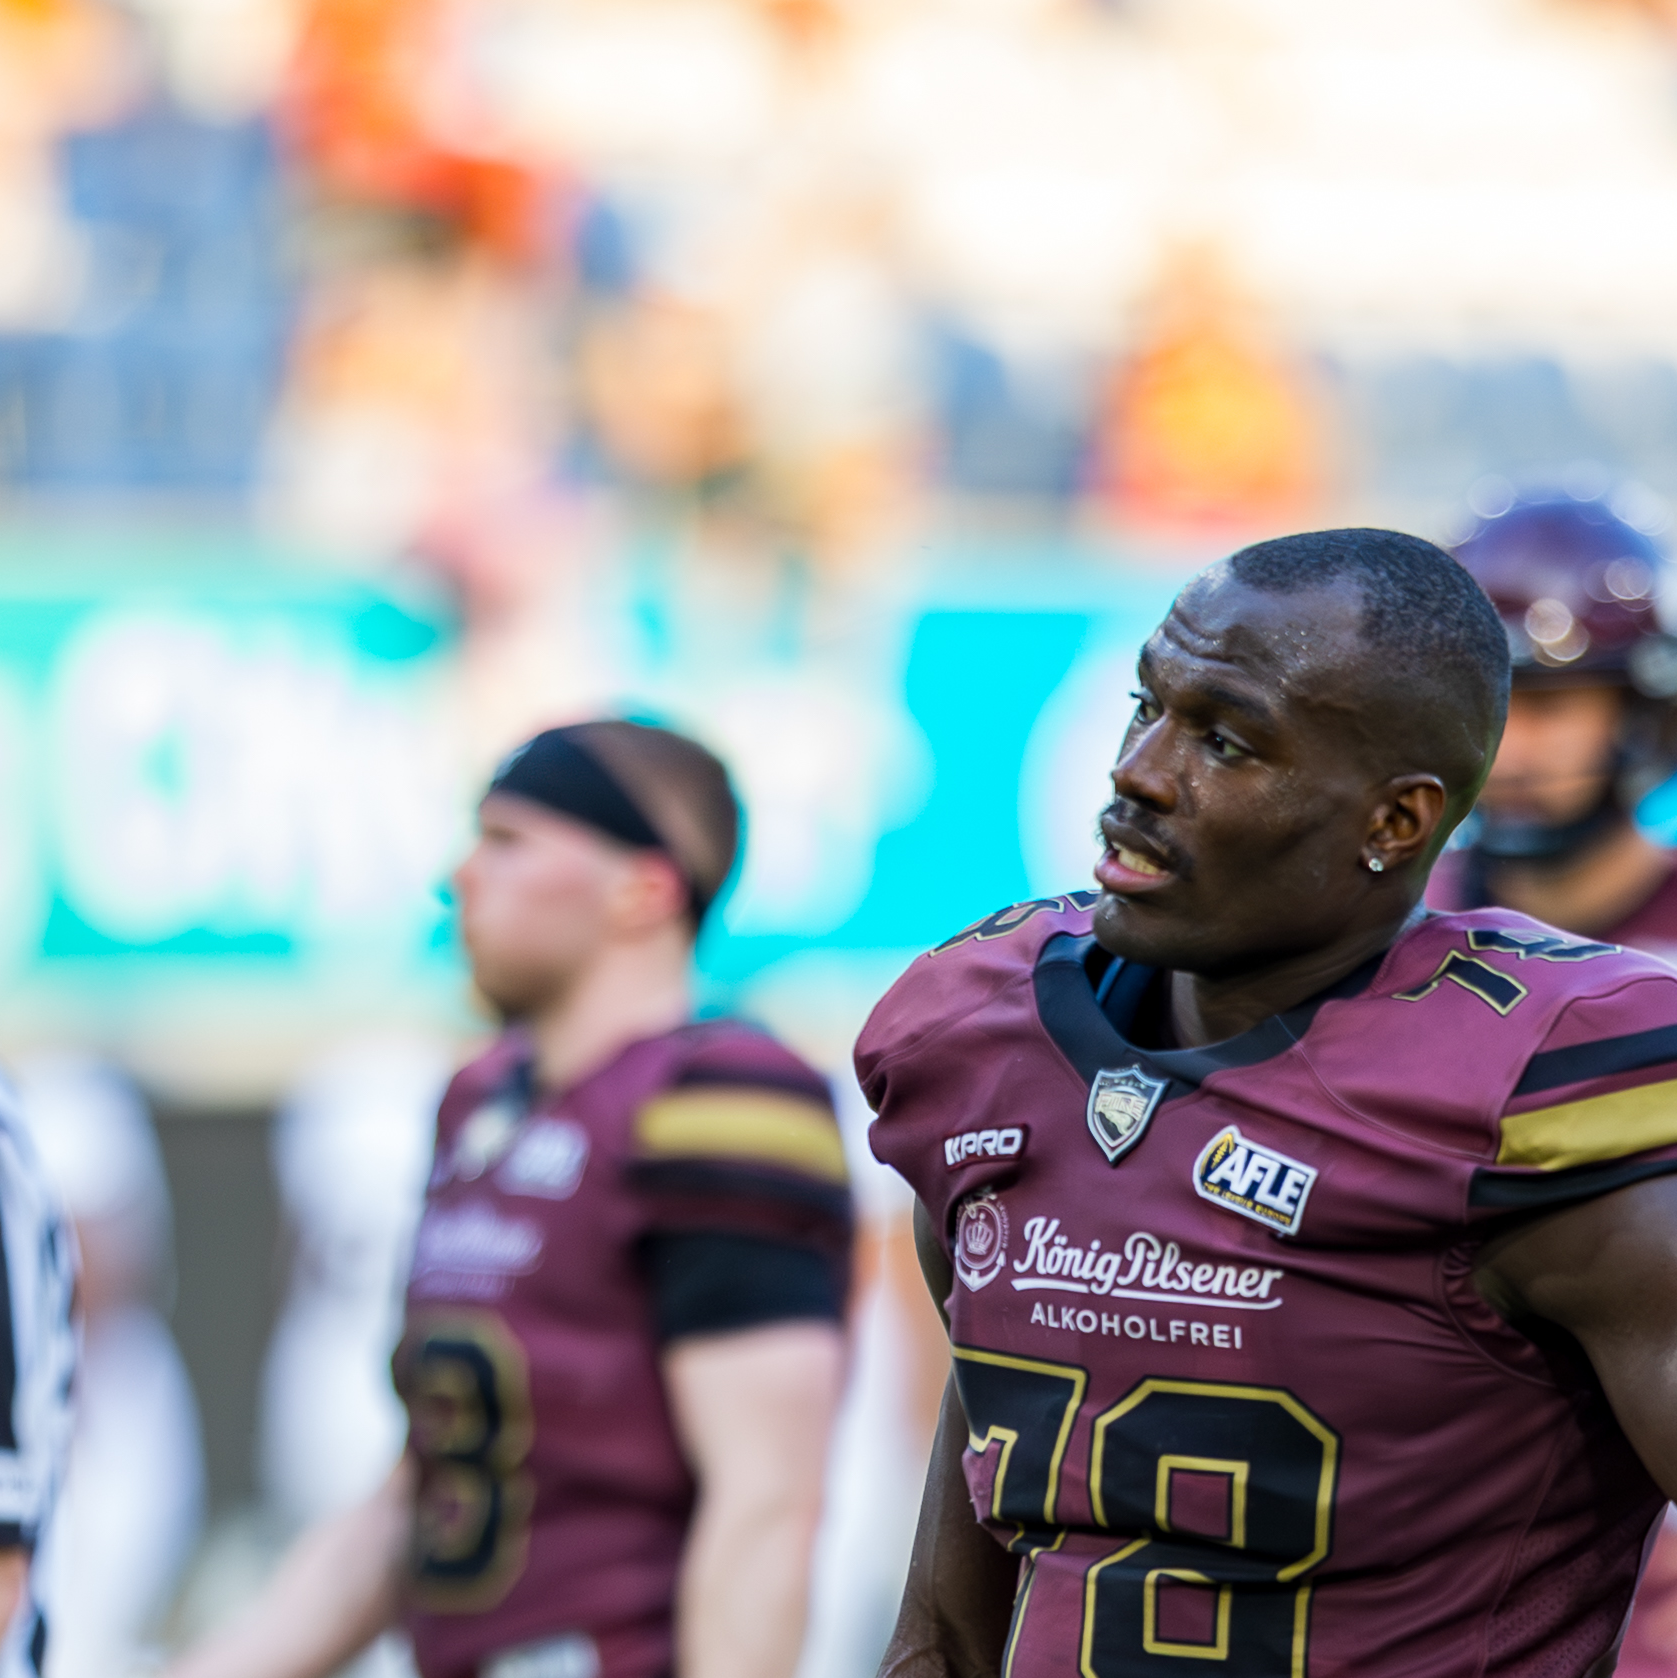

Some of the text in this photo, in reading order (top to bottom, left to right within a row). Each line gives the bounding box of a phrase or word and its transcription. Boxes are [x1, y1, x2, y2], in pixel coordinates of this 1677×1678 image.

[944, 1128, 1023, 1166] KPRO
[1207, 1145, 1308, 1216] AFLE
[1030, 1301, 1242, 1350] ALKOHOLFREI
